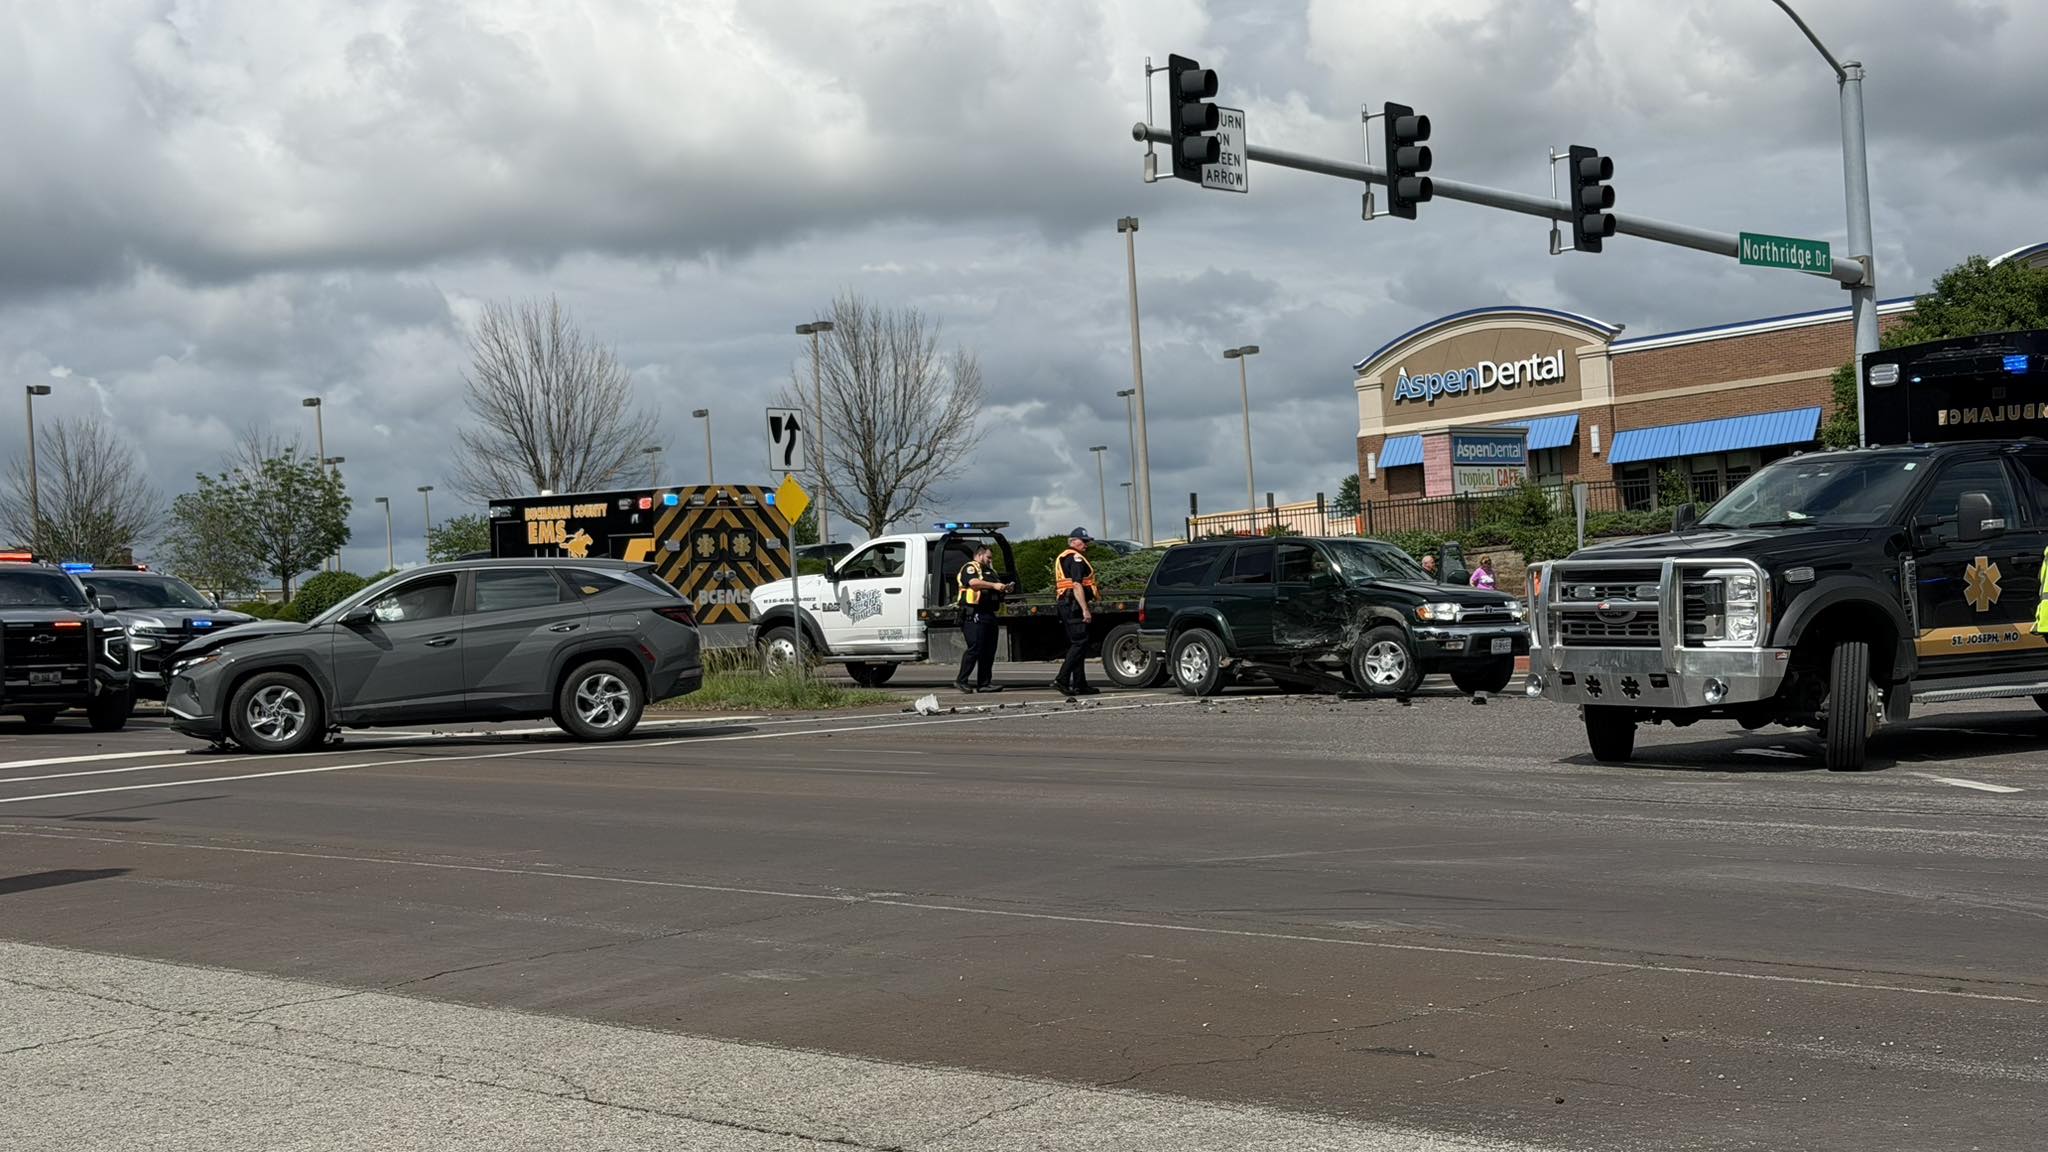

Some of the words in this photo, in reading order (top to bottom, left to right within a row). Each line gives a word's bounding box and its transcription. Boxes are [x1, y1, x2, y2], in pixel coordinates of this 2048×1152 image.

[1220, 112, 1242, 130] URN
[1215, 132, 1230, 146] ON
[1218, 152, 1241, 167] EEN
[1206, 169, 1243, 186] ARROW
[1743, 239, 1811, 268] Northridge
[1815, 250, 1827, 266] Dr
[1393, 349, 1565, 401] AspenDental
[1456, 439, 1521, 460] AspenDental
[1459, 469, 1494, 488] tropical
[524, 504, 572, 521] BUCHANAN
[573, 503, 608, 519] COUNTY
[527, 520, 567, 544] EMS
[699, 589, 751, 605] BCEMS
[1966, 633, 2000, 644] JOSEPH,
[2003, 632, 2019, 641] MO
